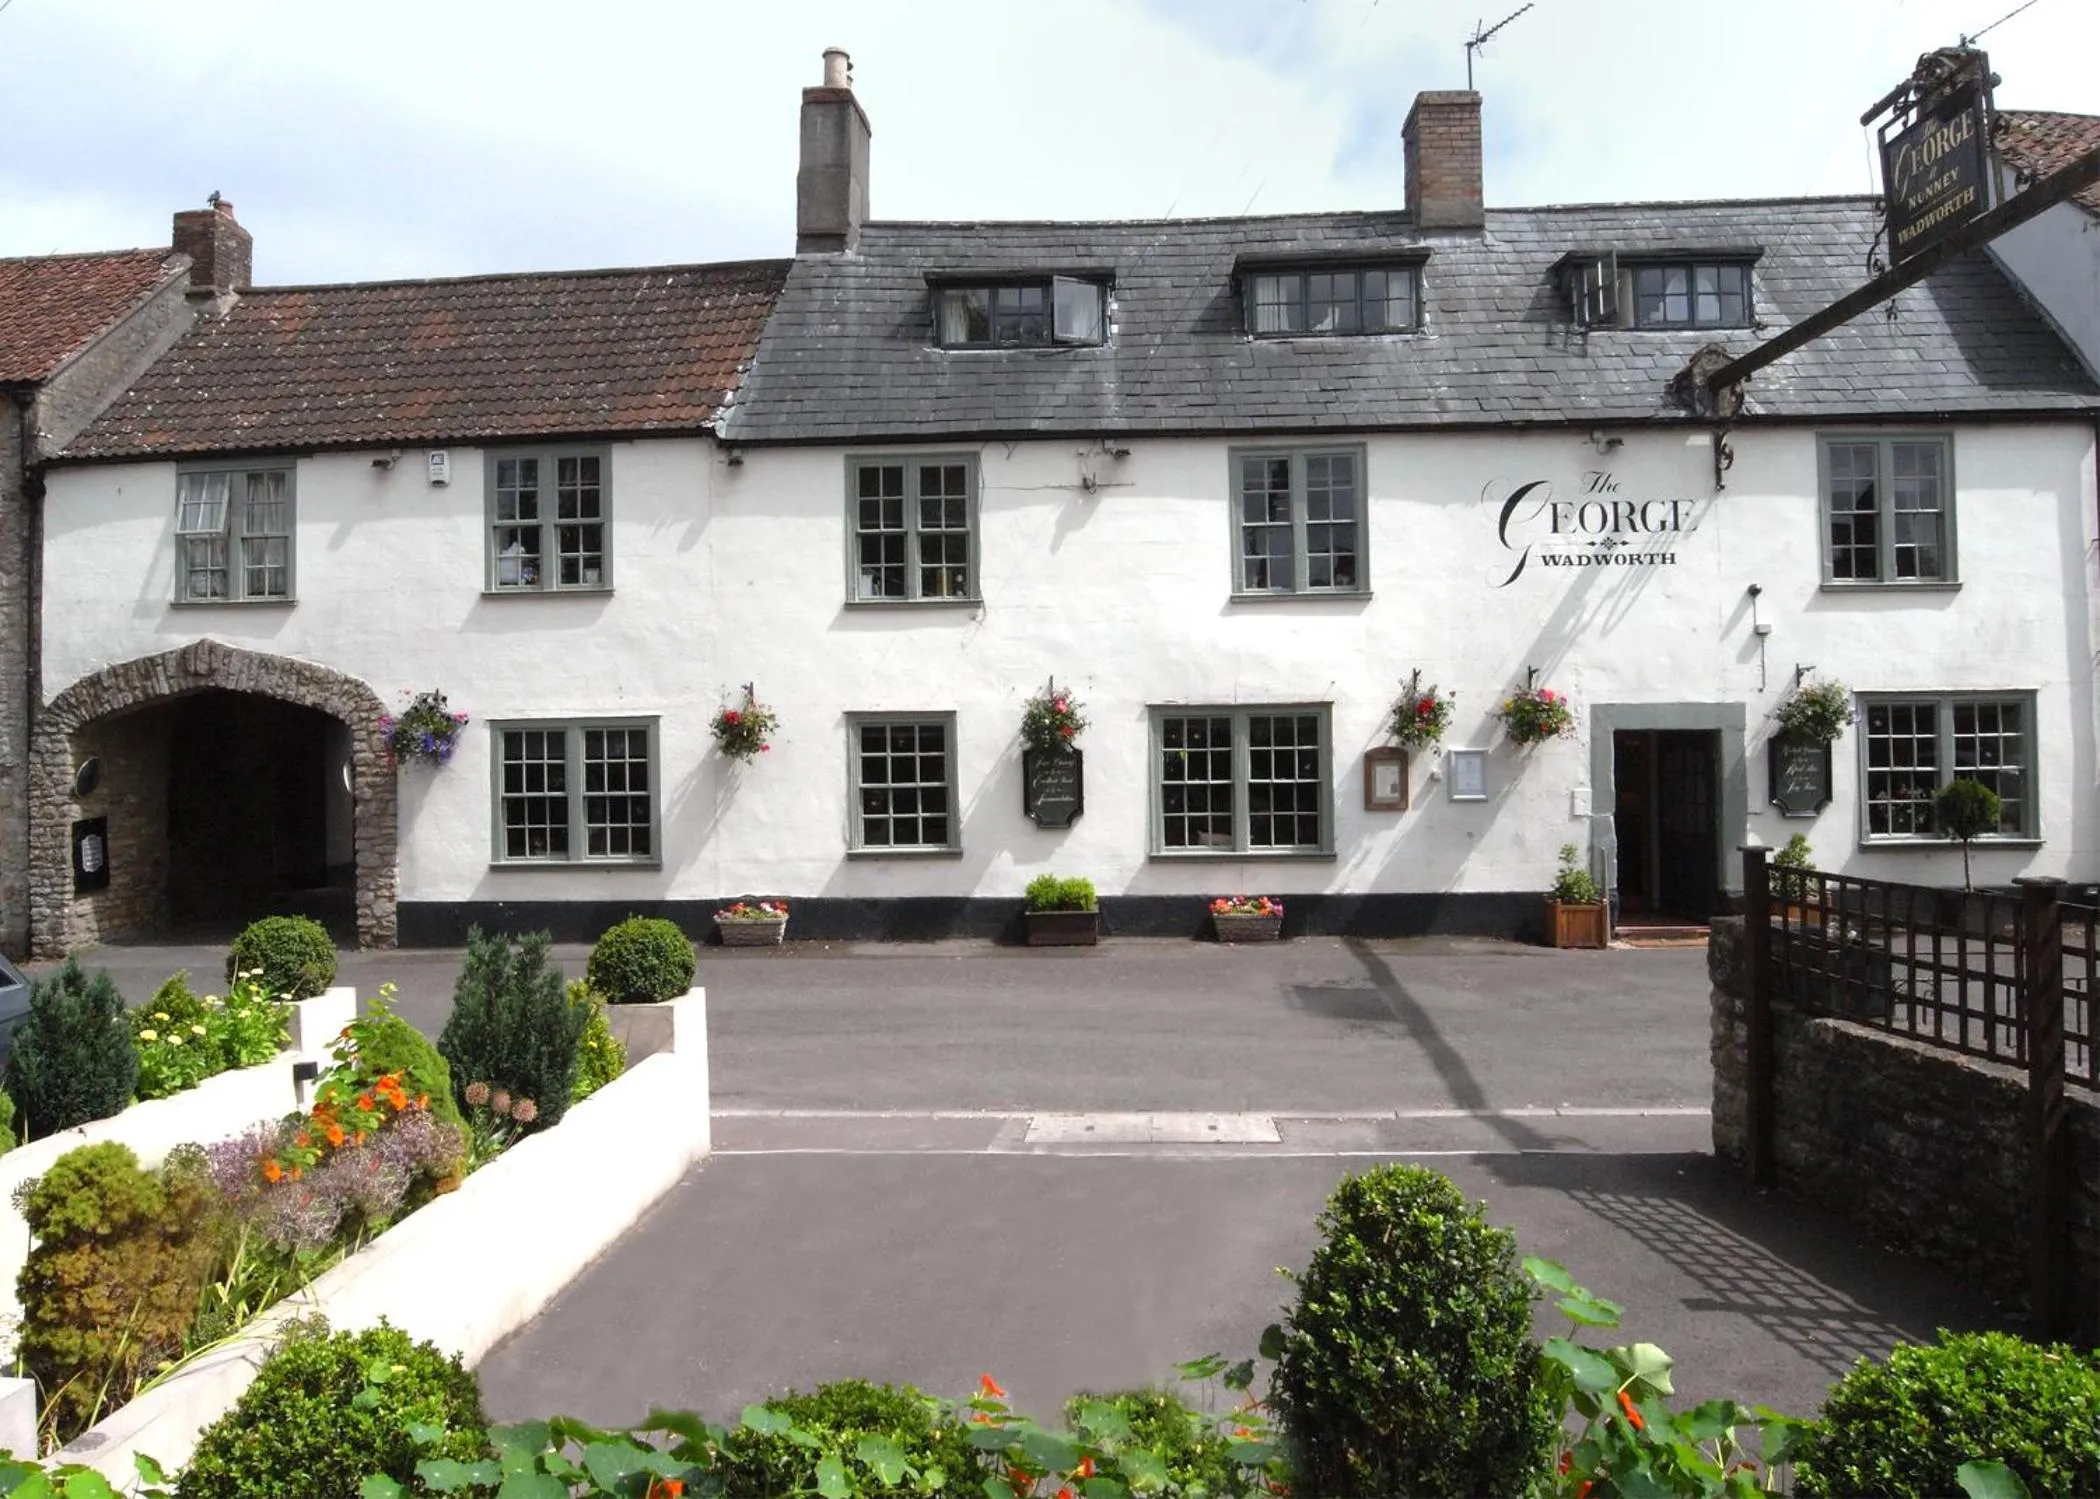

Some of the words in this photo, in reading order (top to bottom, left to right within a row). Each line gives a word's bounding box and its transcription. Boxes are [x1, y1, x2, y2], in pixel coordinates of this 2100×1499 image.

[1893, 108, 1975, 204] GEORGE
[1907, 166, 1961, 211] NUNNEY
[1896, 185, 1975, 246] WADWORTH
[1580, 470, 1622, 494] The
[1481, 475, 1698, 588] GEORGE
[1540, 552, 1677, 567] WADWORTH
